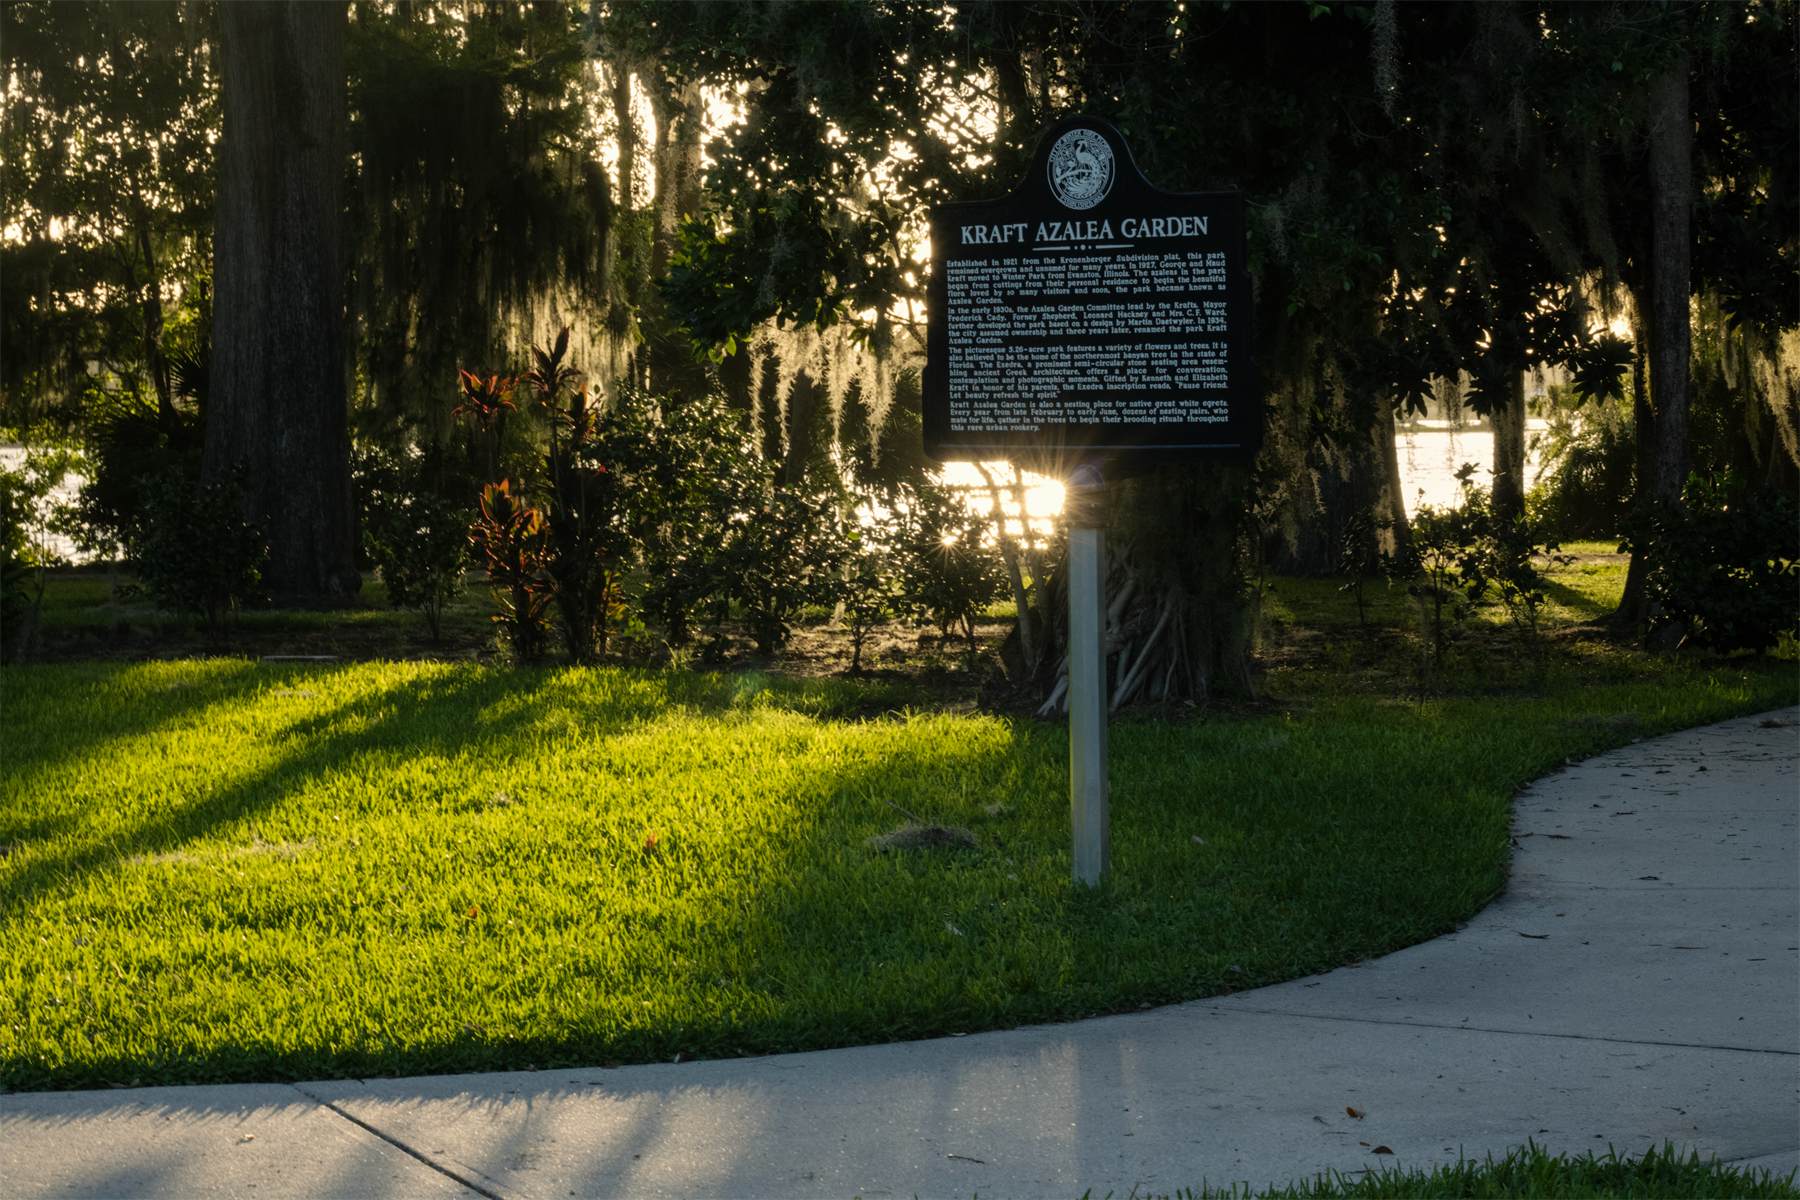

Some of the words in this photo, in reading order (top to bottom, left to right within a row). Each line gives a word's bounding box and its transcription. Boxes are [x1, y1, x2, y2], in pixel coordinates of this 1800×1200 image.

[961, 223, 1028, 244] KRAFT
[1035, 219, 1114, 242] AZALEA
[1120, 216, 1208, 238] GARDEN
[947, 259, 987, 267] Established
[1023, 257, 1039, 265] from
[1116, 253, 1159, 262] Subdivision
[1207, 251, 1225, 260] park
[947, 267, 979, 275] remained
[981, 267, 1017, 275] overgrown
[1083, 264, 1101, 272] many
[1160, 260, 1186, 270] George
[1206, 259, 1225, 267] Maud
[947, 274, 966, 282] Kraft
[1029, 272, 1045, 280] Park
[1151, 268, 1177, 276] azaleas
[1208, 267, 1226, 276] park
[948, 282, 969, 291] began
[972, 281, 989, 289] from
[993, 280, 1022, 290] cuttings
[1046, 279, 1064, 287] their
[1068, 278, 1099, 288] personal
[1154, 276, 1174, 285] begin
[1192, 275, 1226, 283] beautiful
[970, 289, 989, 297] loved
[1019, 289, 1038, 297] many
[1043, 287, 1070, 295] visitors
[1075, 286, 1088, 294] and
[1116, 285, 1128, 293] the
[1133, 285, 1151, 294] park
[1189, 283, 1212, 291] known
[972, 306, 991, 315] early
[1058, 304, 1084, 312] Garden
[1087, 303, 1125, 311] Committee
[1203, 300, 1226, 310] Mayor
[948, 314, 982, 322] Frederick
[1084, 311, 1113, 319] Leonard
[977, 321, 1011, 330] developed
[1029, 320, 1045, 329] park
[1091, 319, 1113, 328] design
[1128, 318, 1152, 326] Martin
[963, 329, 977, 338] city
[1011, 328, 1047, 337] ownership
[1089, 328, 1109, 336] years
[1134, 325, 1165, 333] renamed
[1186, 325, 1203, 334] park
[1207, 324, 1227, 332] Kraft
[1047, 345, 1064, 354] park
[1067, 344, 1096, 352] features
[1105, 343, 1132, 352] variety
[1174, 342, 1187, 350] and
[965, 353, 994, 361] believed
[1074, 351, 1120, 359] northernmost
[1123, 351, 1149, 360] banyan
[1182, 350, 1193, 358] the
[1036, 360, 1071, 369] prominent
[1151, 358, 1178, 367] seating
[1006, 368, 1027, 376] Greek
[1127, 367, 1147, 376] place
[1156, 366, 1167, 374] for
[949, 376, 999, 385] contemplation
[1018, 375, 1065, 384] photographic
[965, 391, 989, 400] beauty
[1064, 400, 1090, 409] nesting
[1094, 400, 1112, 409] place
[1155, 400, 1175, 408] great
[950, 408, 970, 417] Every
[1031, 408, 1063, 417] February
[1077, 408, 1096, 417] early
[1160, 407, 1186, 416] nesting
[998, 416, 1021, 425] gather
[1080, 416, 1100, 424] begin
[1124, 415, 1156, 424] brooding
[1187, 415, 1228, 424] throughout
